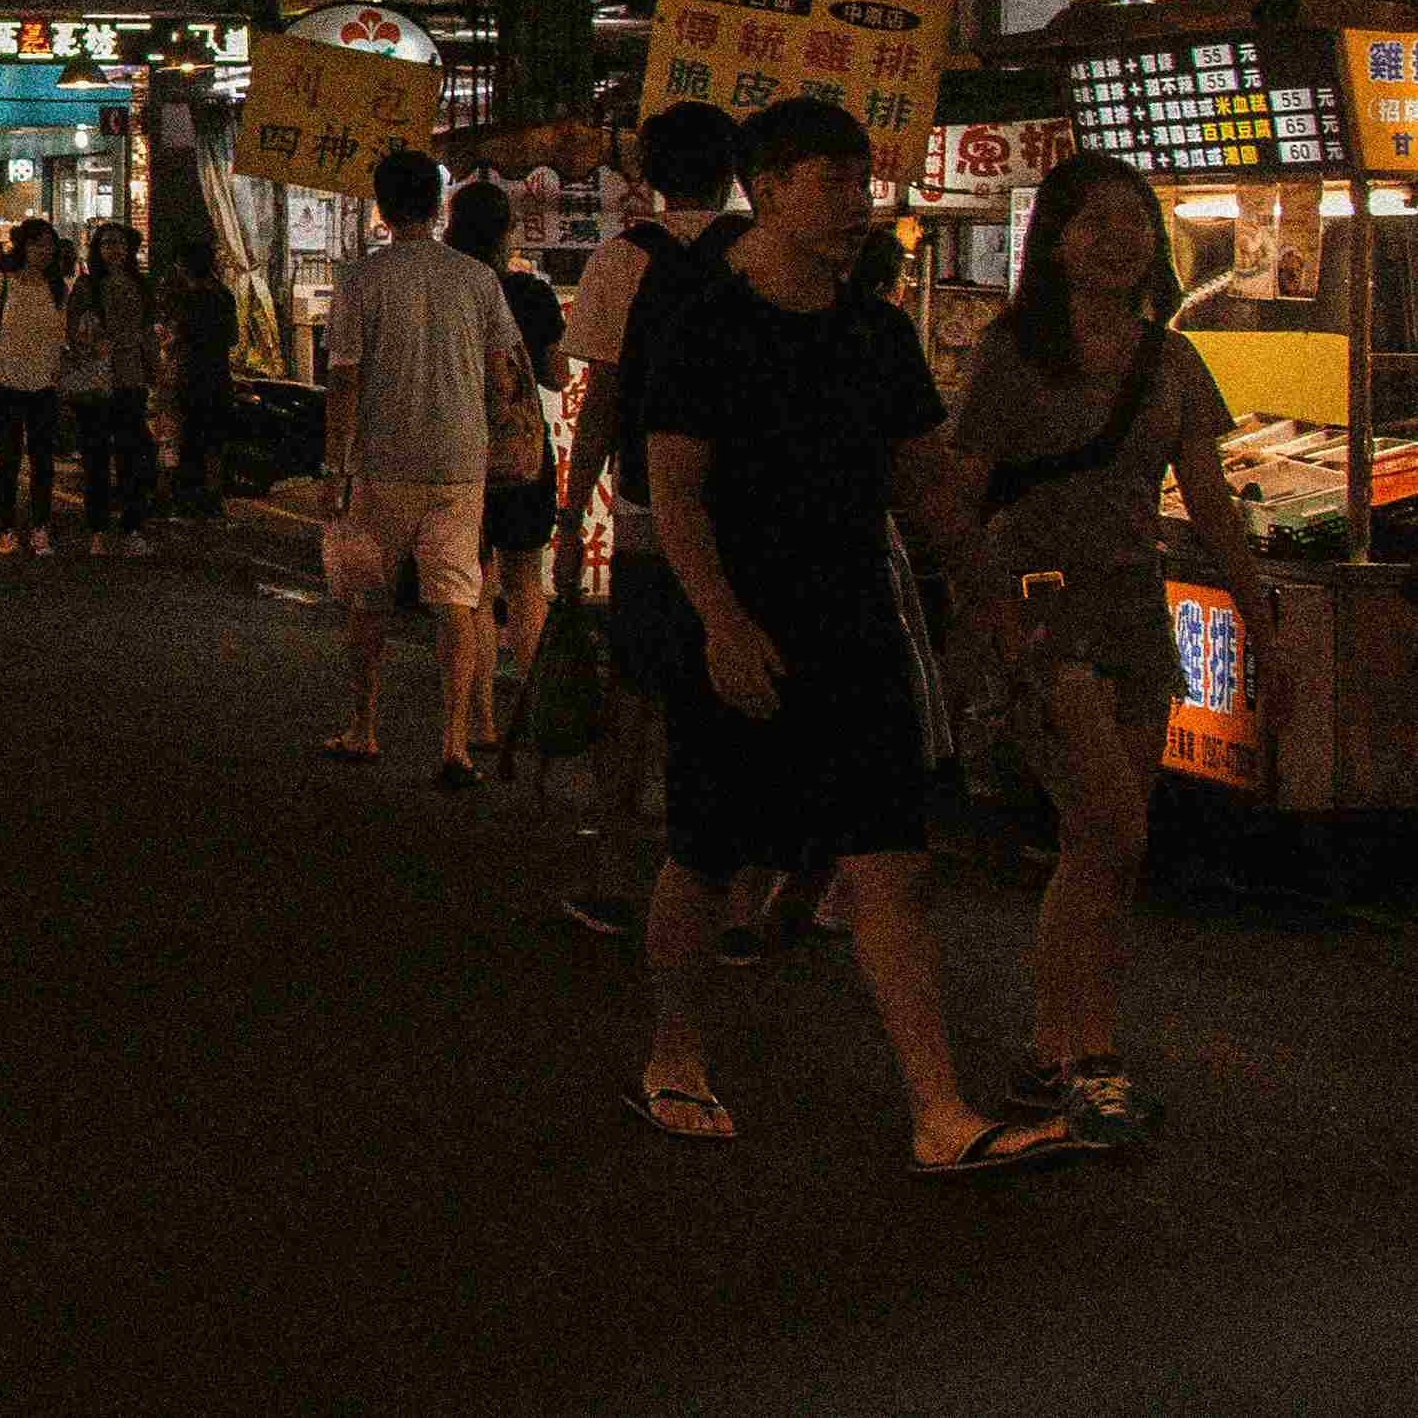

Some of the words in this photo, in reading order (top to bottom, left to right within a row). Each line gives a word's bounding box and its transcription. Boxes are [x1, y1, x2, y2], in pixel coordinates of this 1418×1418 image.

[1203, 45, 1222, 64] 55
[1240, 43, 1258, 63] 元
[1206, 73, 1226, 91] 55
[1244, 69, 1262, 89] 元
[1282, 91, 1302, 109] 55
[1317, 87, 1336, 108] 元
[1285, 116, 1307, 134] 65
[1322, 115, 1340, 134] 元
[1290, 142, 1310, 160] 60
[1326, 141, 1345, 161] 元
